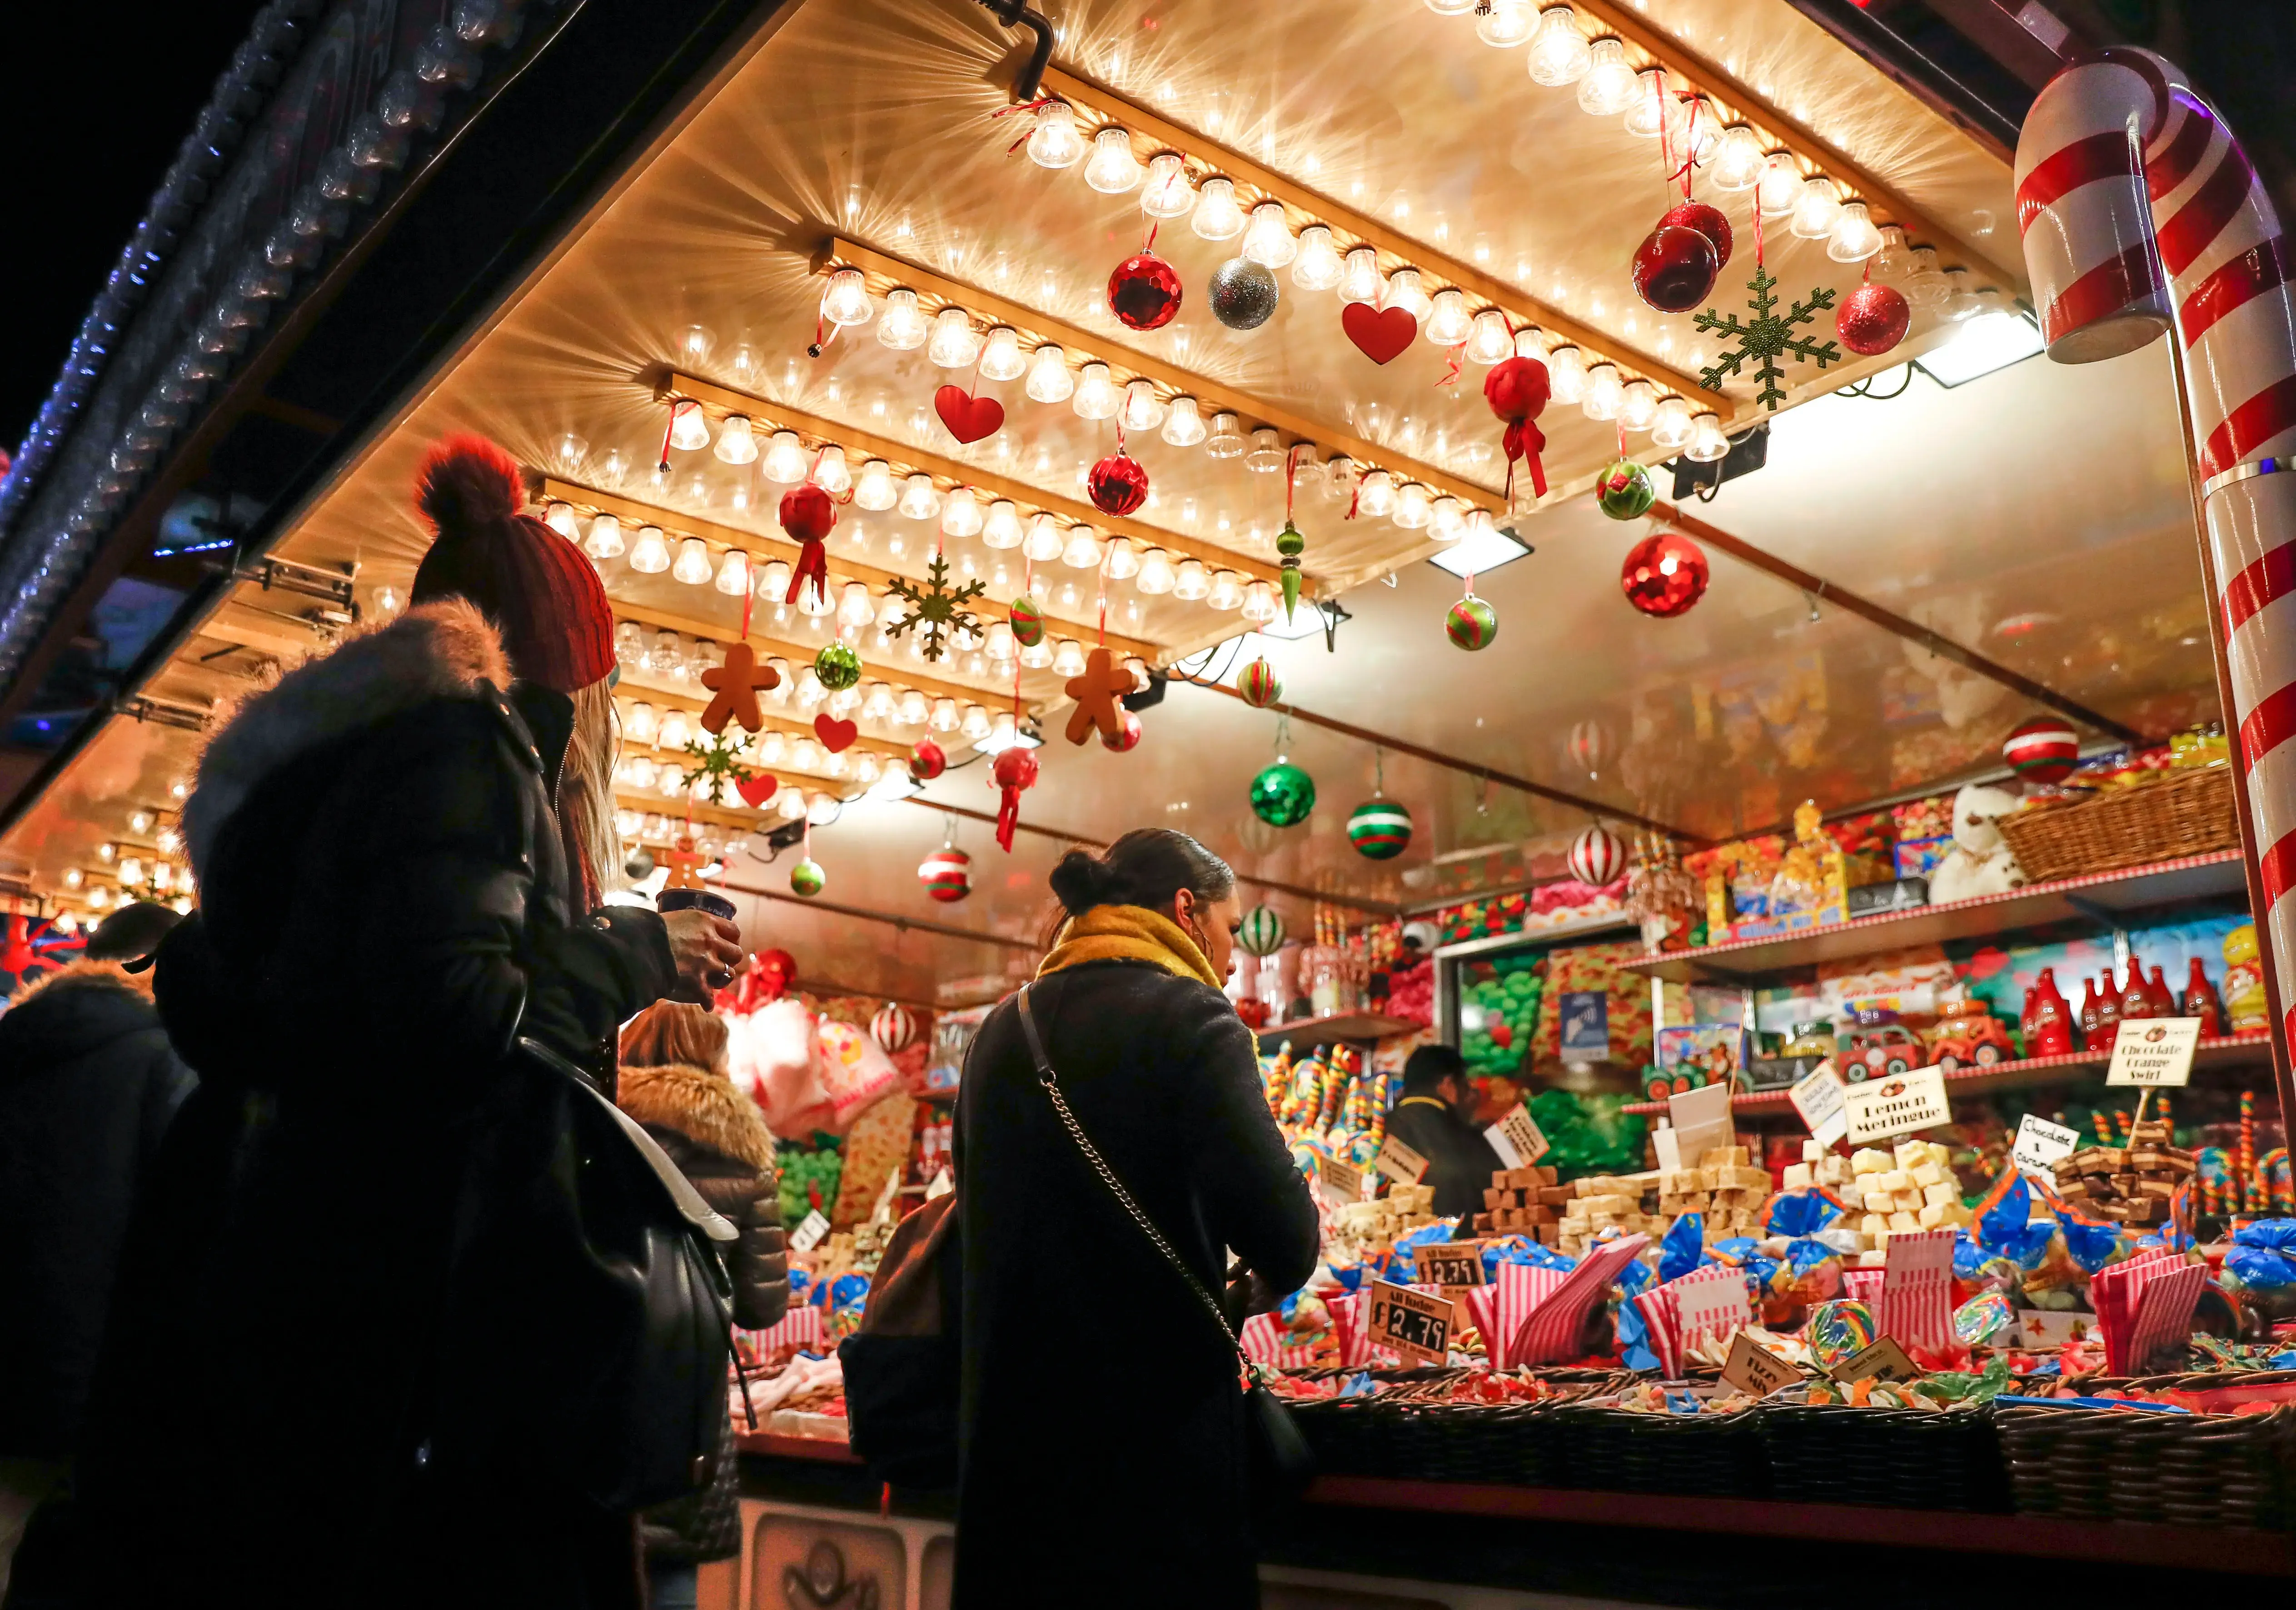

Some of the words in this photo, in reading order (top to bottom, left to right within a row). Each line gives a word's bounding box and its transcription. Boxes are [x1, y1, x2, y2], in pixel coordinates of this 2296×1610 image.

[2121, 1044, 2182, 1055] Chocolate
[2127, 1058, 2171, 1068] Orange
[2131, 1070, 2161, 1080] Swirl
[1864, 1096, 1926, 1117] Lemon
[1856, 1108, 1940, 1132] Meringue
